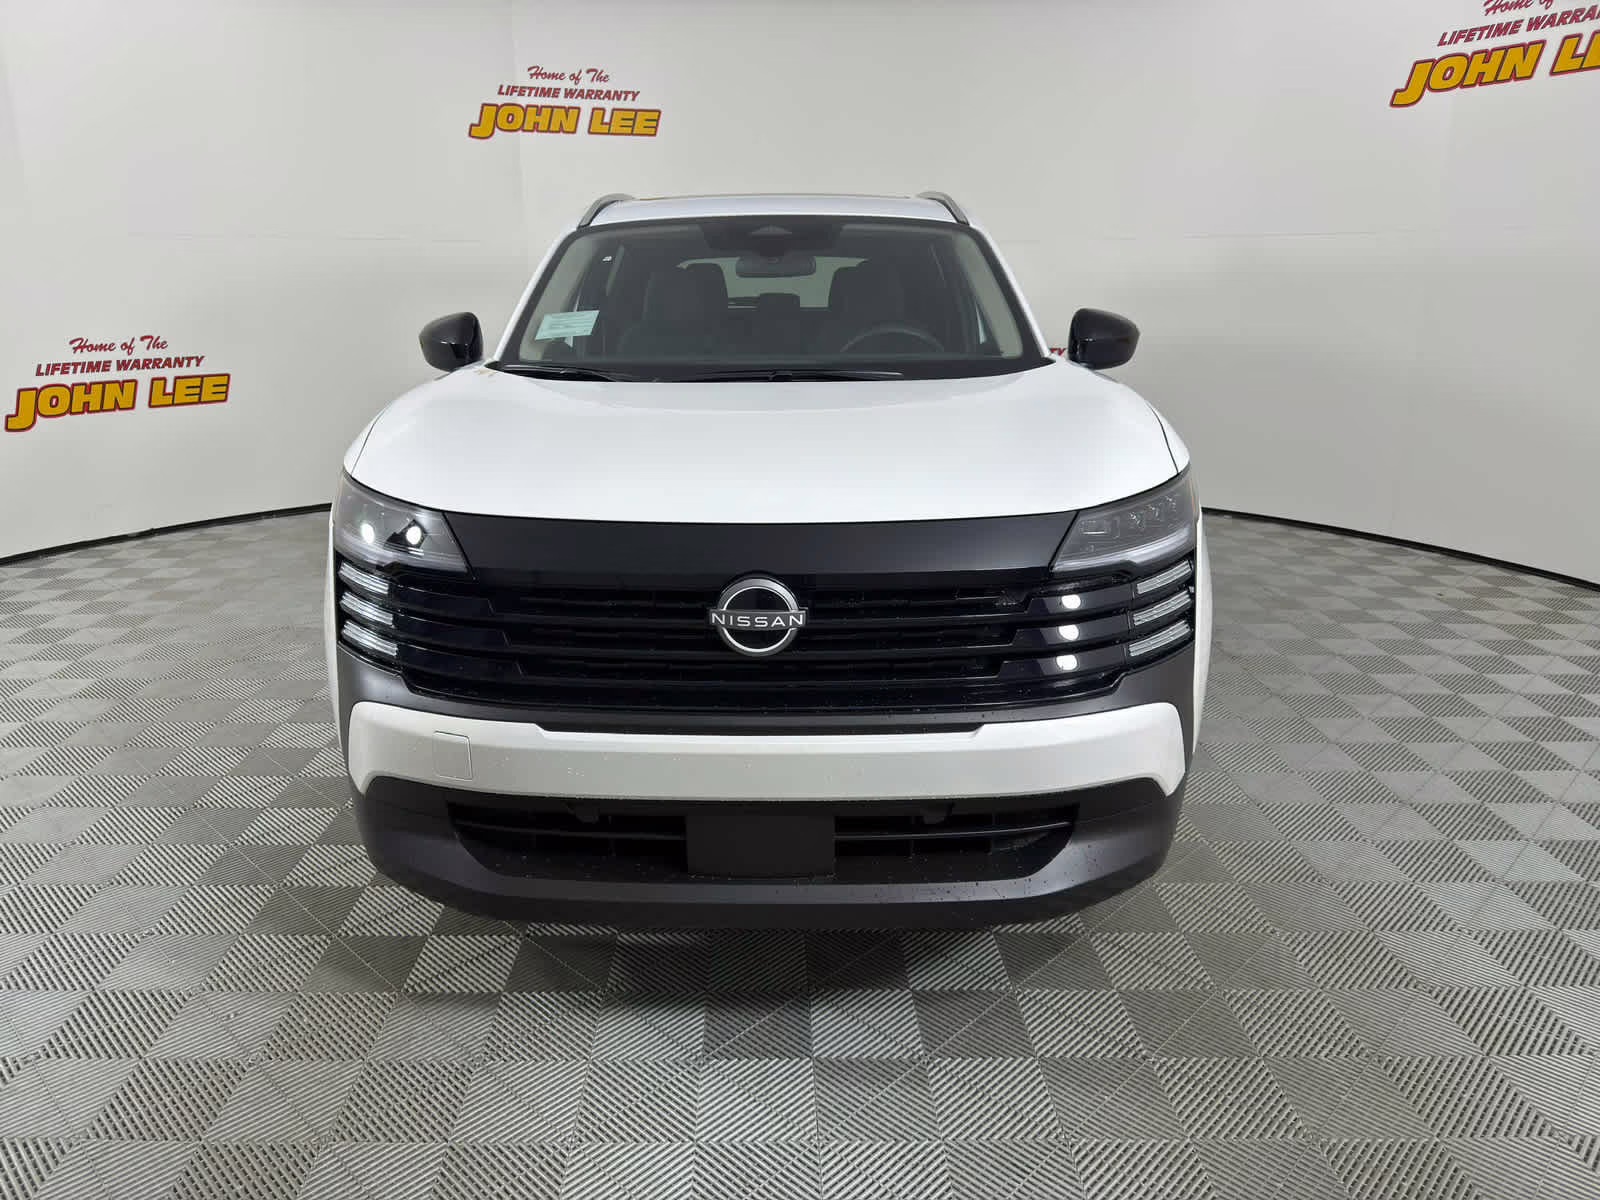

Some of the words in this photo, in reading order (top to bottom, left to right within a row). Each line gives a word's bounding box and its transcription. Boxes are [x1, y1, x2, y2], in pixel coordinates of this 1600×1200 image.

[1437, 19, 1525, 47] LIFETIME
[527, 66, 566, 81] Home
[569, 69, 582, 84] of
[586, 68, 610, 83] The
[1389, 39, 1547, 109] JOHN
[497, 84, 561, 99] LIFETIME
[564, 88, 640, 102] WARRANTY
[468, 103, 581, 140] JOHN
[588, 107, 662, 137] LEE
[69, 337, 116, 354] Home
[120, 337, 135, 356] of
[140, 335, 168, 351] The
[35, 359, 112, 377] LIFETIME
[115, 355, 205, 372] WARRANTY
[5, 379, 138, 432] JOHN
[148, 373, 231, 408] LEE
[711, 612, 803, 627] NISSAN
